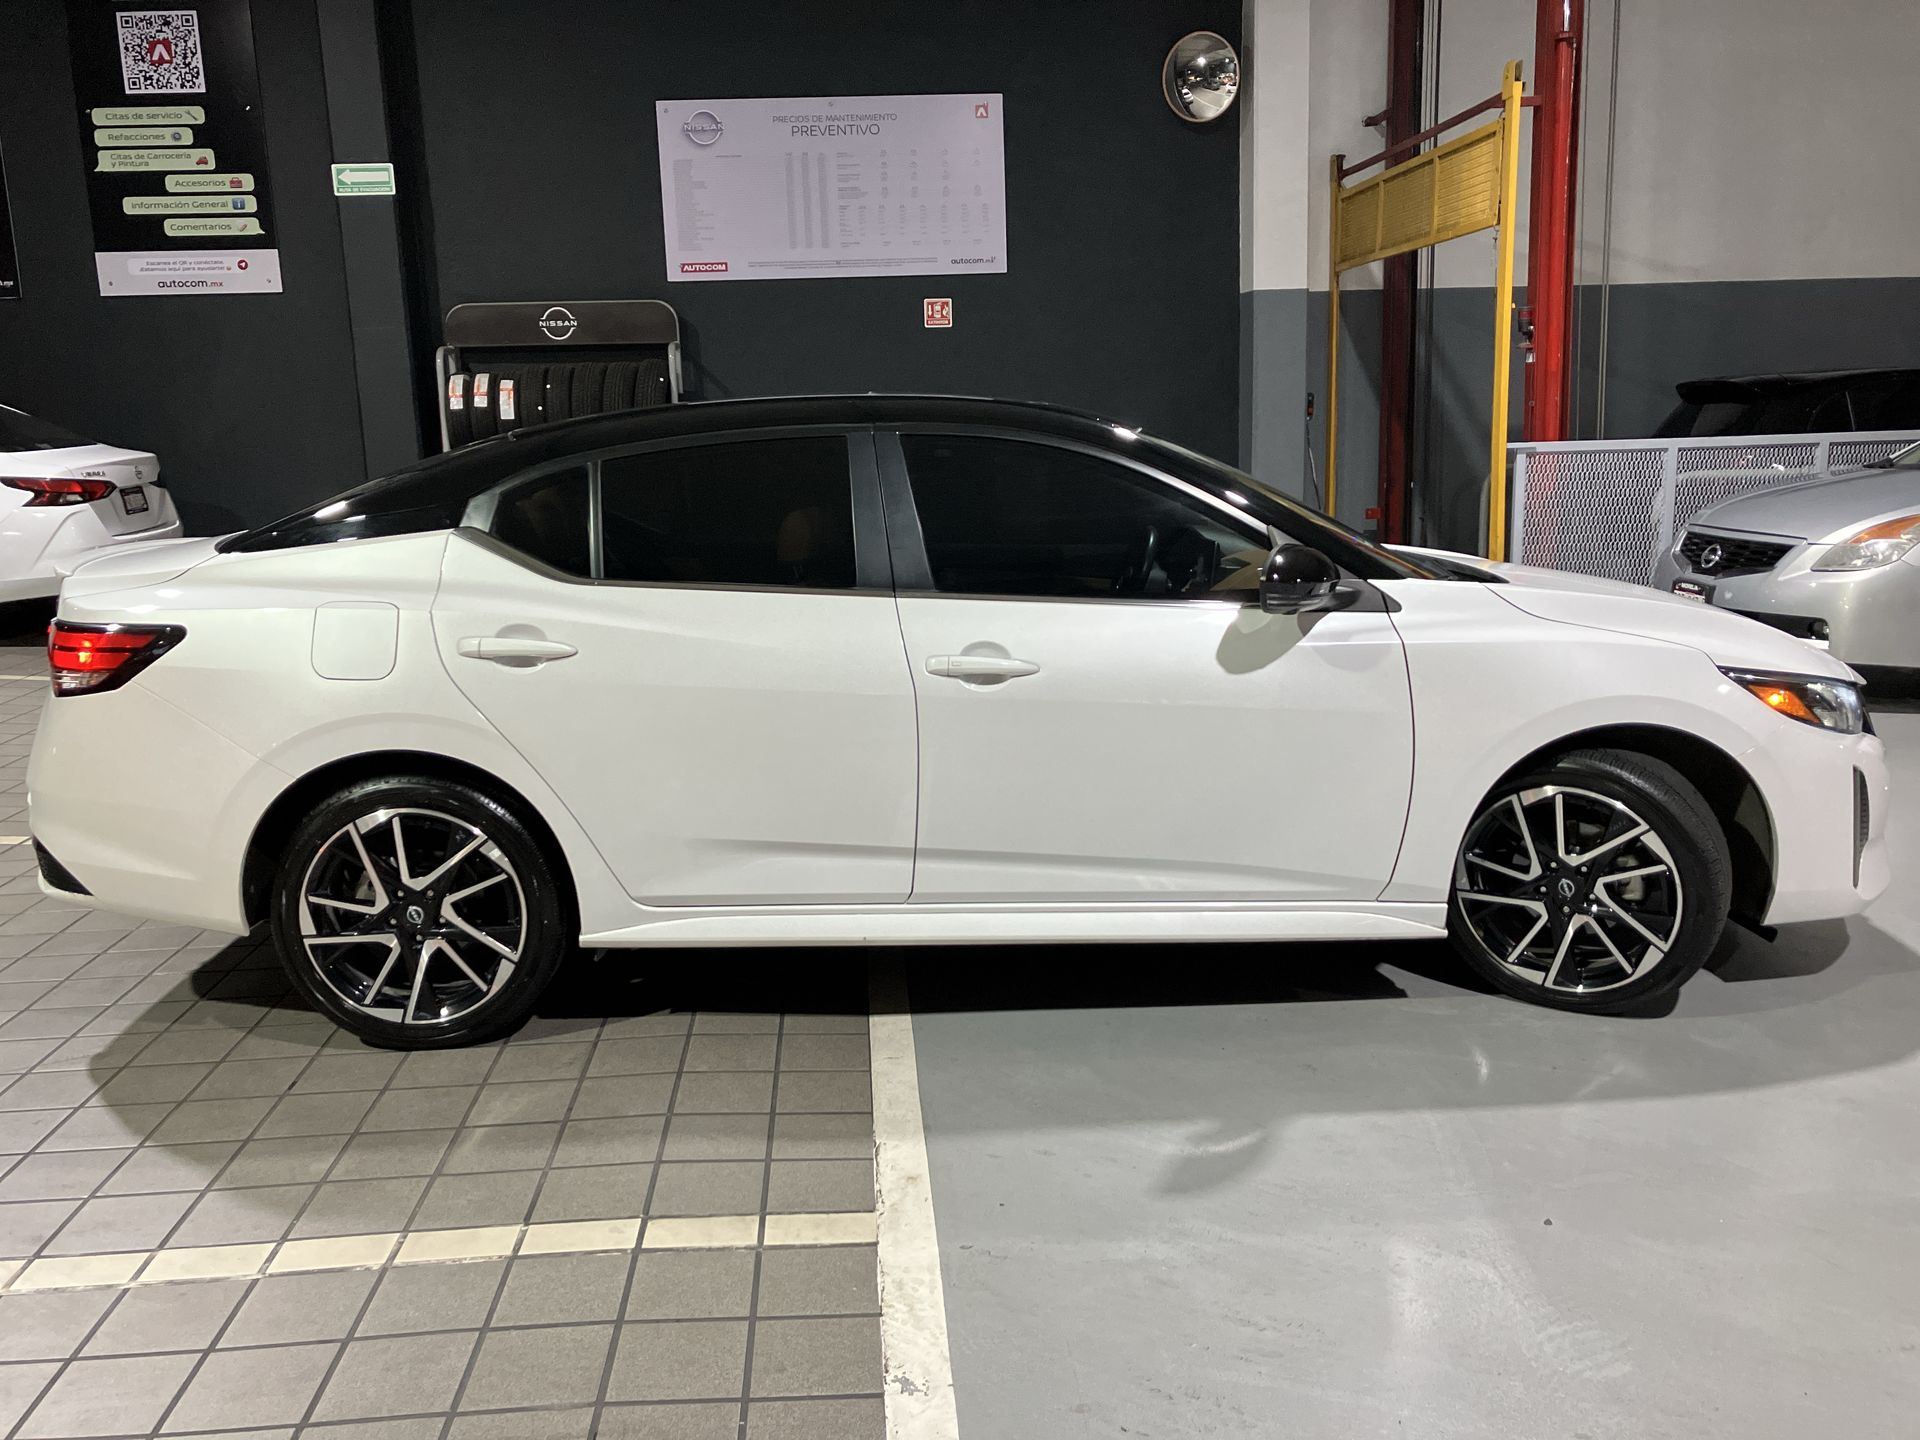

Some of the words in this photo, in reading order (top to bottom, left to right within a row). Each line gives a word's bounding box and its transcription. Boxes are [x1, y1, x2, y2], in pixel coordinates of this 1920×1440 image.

[105, 112, 130, 120] Citas
[131, 112, 144, 120] de
[146, 111, 183, 120] servicio
[772, 115, 810, 123] PRECIOS
[825, 113, 898, 122] MANTENIMIENTO
[684, 122, 725, 132] NISSAN
[791, 124, 881, 137] PREVENTIVO
[107, 133, 166, 141] Refacciones
[174, 179, 226, 187] Accesorios
[131, 200, 190, 209] Información
[192, 200, 229, 208] General
[170, 223, 232, 231] Comentarios
[157, 279, 224, 288] autocom.mx
